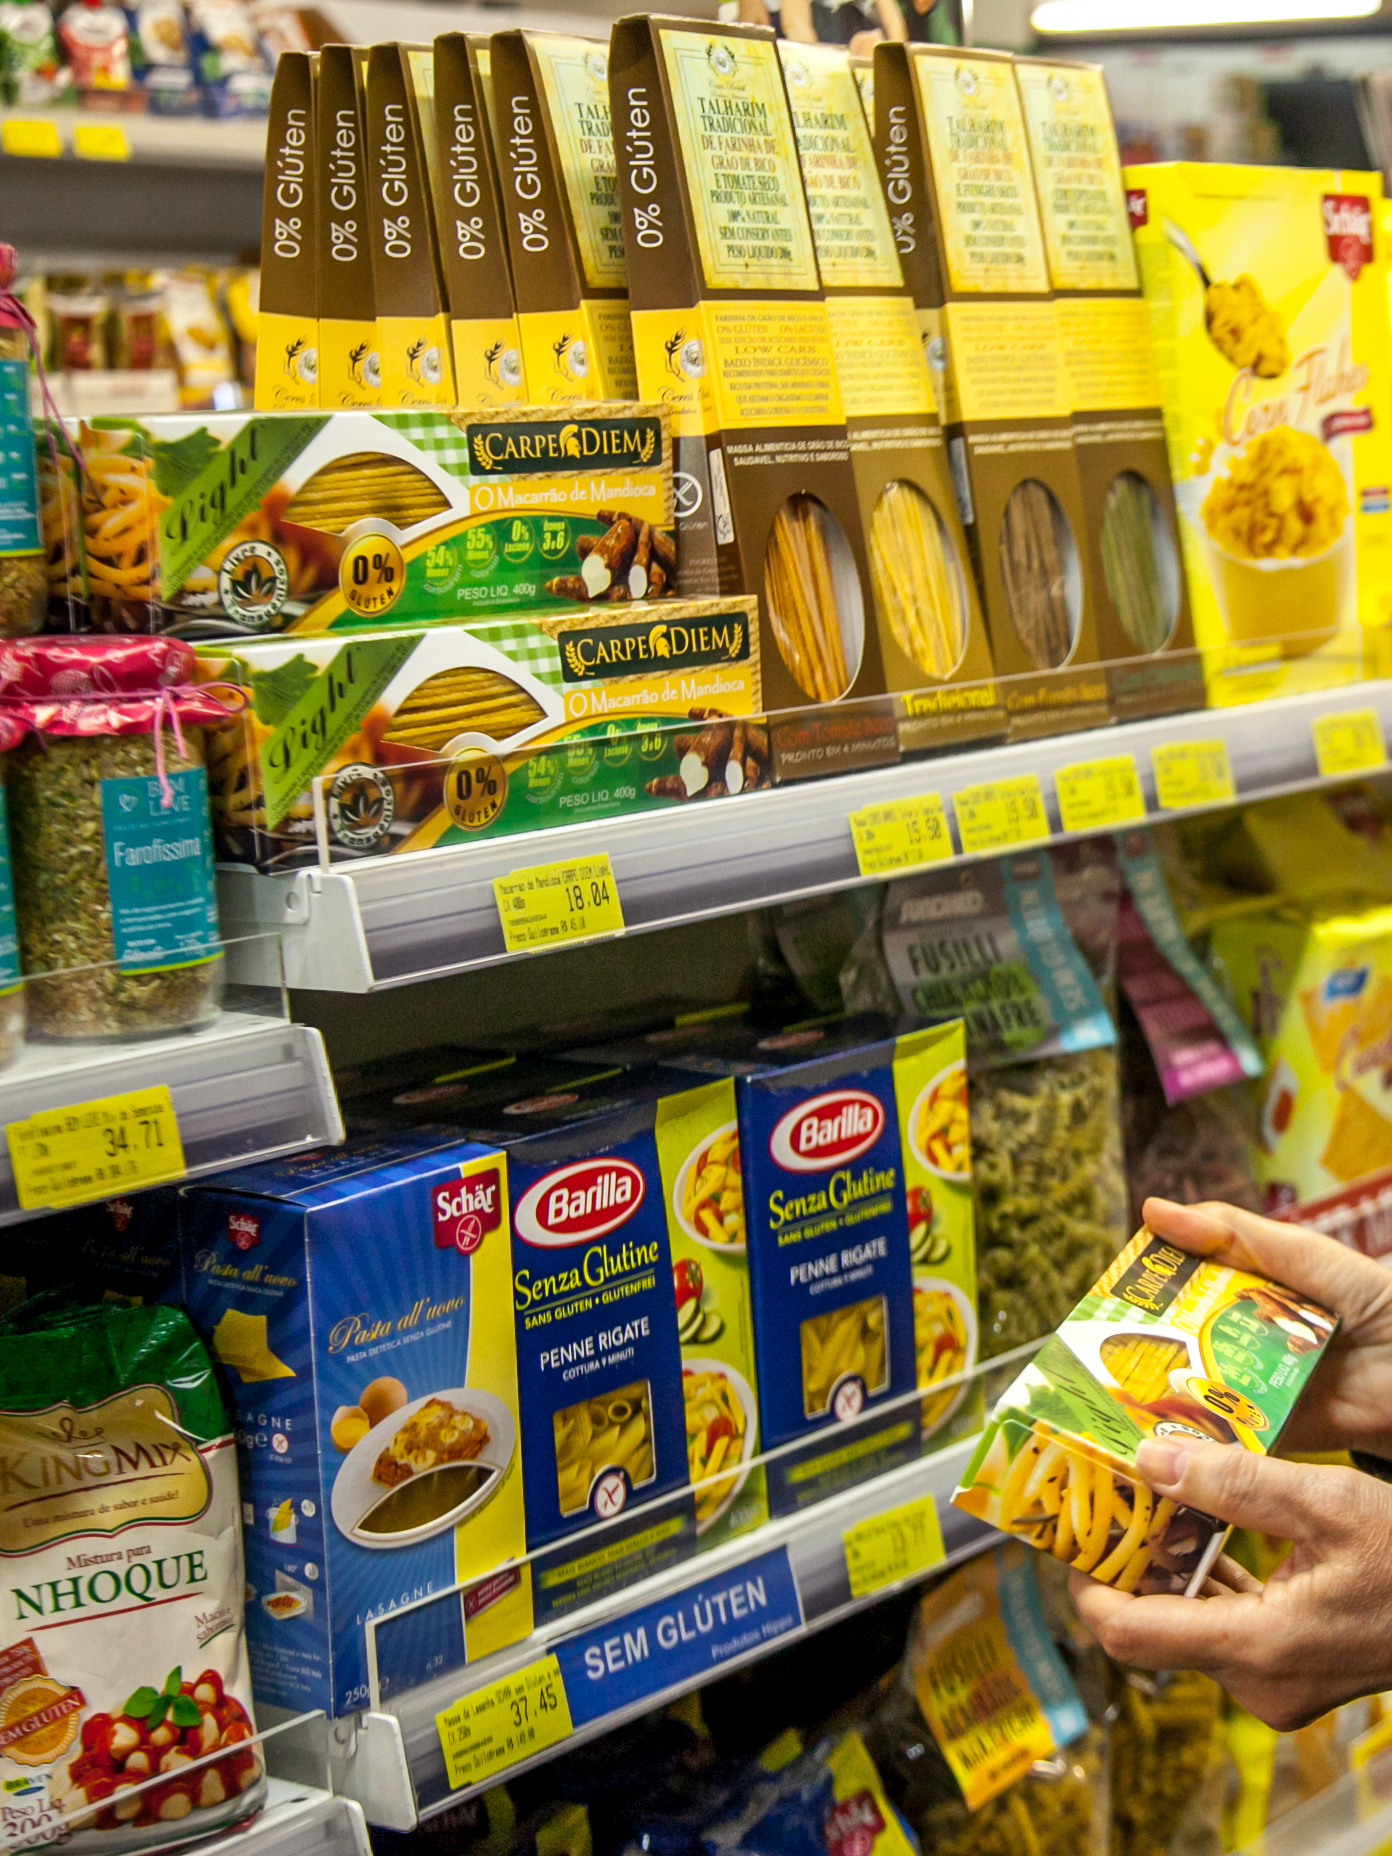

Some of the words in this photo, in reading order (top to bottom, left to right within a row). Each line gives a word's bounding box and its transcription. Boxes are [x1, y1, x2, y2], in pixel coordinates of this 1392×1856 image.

[697, 97, 768, 118] TALHARIM
[700, 115, 772, 137] TRADICIONAL
[276, 108, 306, 208] Glúten
[329, 109, 356, 211] Glúten
[379, 104, 408, 206] Glúten
[450, 104, 480, 207] Glúten
[509, 95, 542, 200] Glúten
[626, 87, 657, 194] Glúten
[701, 134, 717, 150] DE
[718, 136, 761, 154] FARINHA
[885, 105, 912, 204] Glúten
[723, 173, 757, 192] TOMATE
[758, 175, 779, 192] SECO
[755, 158, 776, 174] BICO
[274, 217, 302, 258] 0%
[383, 215, 412, 258] 0%
[456, 216, 485, 260] 0%
[518, 208, 549, 252] 0%
[634, 203, 663, 248] 0%
[746, 210, 780, 226] NATURAL
[331, 219, 358, 262] 0%
[732, 323, 769, 335] GLÚTEN
[723, 358, 752, 368] BAIXO
[735, 346, 772, 355] LOW
[777, 345, 818, 354] CARB
[485, 432, 559, 461] CARPE
[581, 427, 643, 456] DIEM
[473, 485, 494, 511] O
[496, 485, 567, 509] Macarrão
[569, 482, 588, 502] de
[589, 477, 656, 502] Mandioca
[466, 527, 494, 550] 55%
[511, 520, 530, 541] 0%
[353, 552, 395, 585] 0%
[426, 545, 453, 568] 54%
[349, 586, 396, 610] GLUTEN
[457, 587, 488, 600] PESO
[512, 583, 536, 597] 400g
[576, 636, 648, 667] CARPE
[668, 625, 731, 655] DIEM
[568, 691, 587, 718] O
[590, 687, 658, 713] Macarrão
[660, 682, 678, 702] de
[680, 674, 745, 700] Mandioca
[902, 682, 996, 717] Tradicional
[456, 765, 497, 801] 0%
[528, 755, 554, 778] 54%
[454, 798, 497, 824] GLUTEN
[559, 793, 589, 808] PESO
[613, 785, 636, 800] 400g
[799, 1103, 874, 1153] Barilla
[436, 1183, 497, 1223] Schär
[547, 1171, 633, 1227] Barilla
[768, 1189, 829, 1230] Senza
[828, 1167, 896, 1210] Glutine
[514, 1267, 583, 1311] Senza
[583, 1240, 660, 1287] Glutine
[790, 1252, 839, 1287] PENNE
[840, 1236, 888, 1269] RIGATE
[524, 1311, 552, 1331] SANS
[554, 1297, 593, 1321] GLUTEN
[601, 1275, 656, 1304] GLUTENFREI
[1126, 1267, 1172, 1303] CARPE
[328, 1312, 393, 1355] Pasta
[346, 1347, 368, 1363] PASTA
[368, 1339, 401, 1357] DIETETICA
[402, 1330, 425, 1346] SENZA
[425, 1321, 452, 1339] GLUTINE
[539, 1335, 595, 1372] PENNE
[598, 1315, 650, 1352] RIGATE
[562, 1359, 600, 1382] COTTURA
[607, 1347, 635, 1366] MINUTI
[1203, 1384, 1241, 1415] 0%
[0, 1441, 192, 1495] KINGMIX
[53, 1505, 96, 1523] mistura
[98, 1502, 111, 1514] de
[112, 1498, 140, 1513] sabor
[66, 1551, 123, 1570] Mistura
[126, 1544, 152, 1563] para
[10, 1549, 208, 1621] NHOQUE
[356, 1581, 435, 1627] LASAGNE
[584, 1625, 649, 1681] SEM
[656, 1575, 767, 1650] GLÚTEN
[711, 1628, 761, 1662] Produtos
[761, 1614, 794, 1638] Hippo
[21, 1694, 81, 1733] GLUTEN
